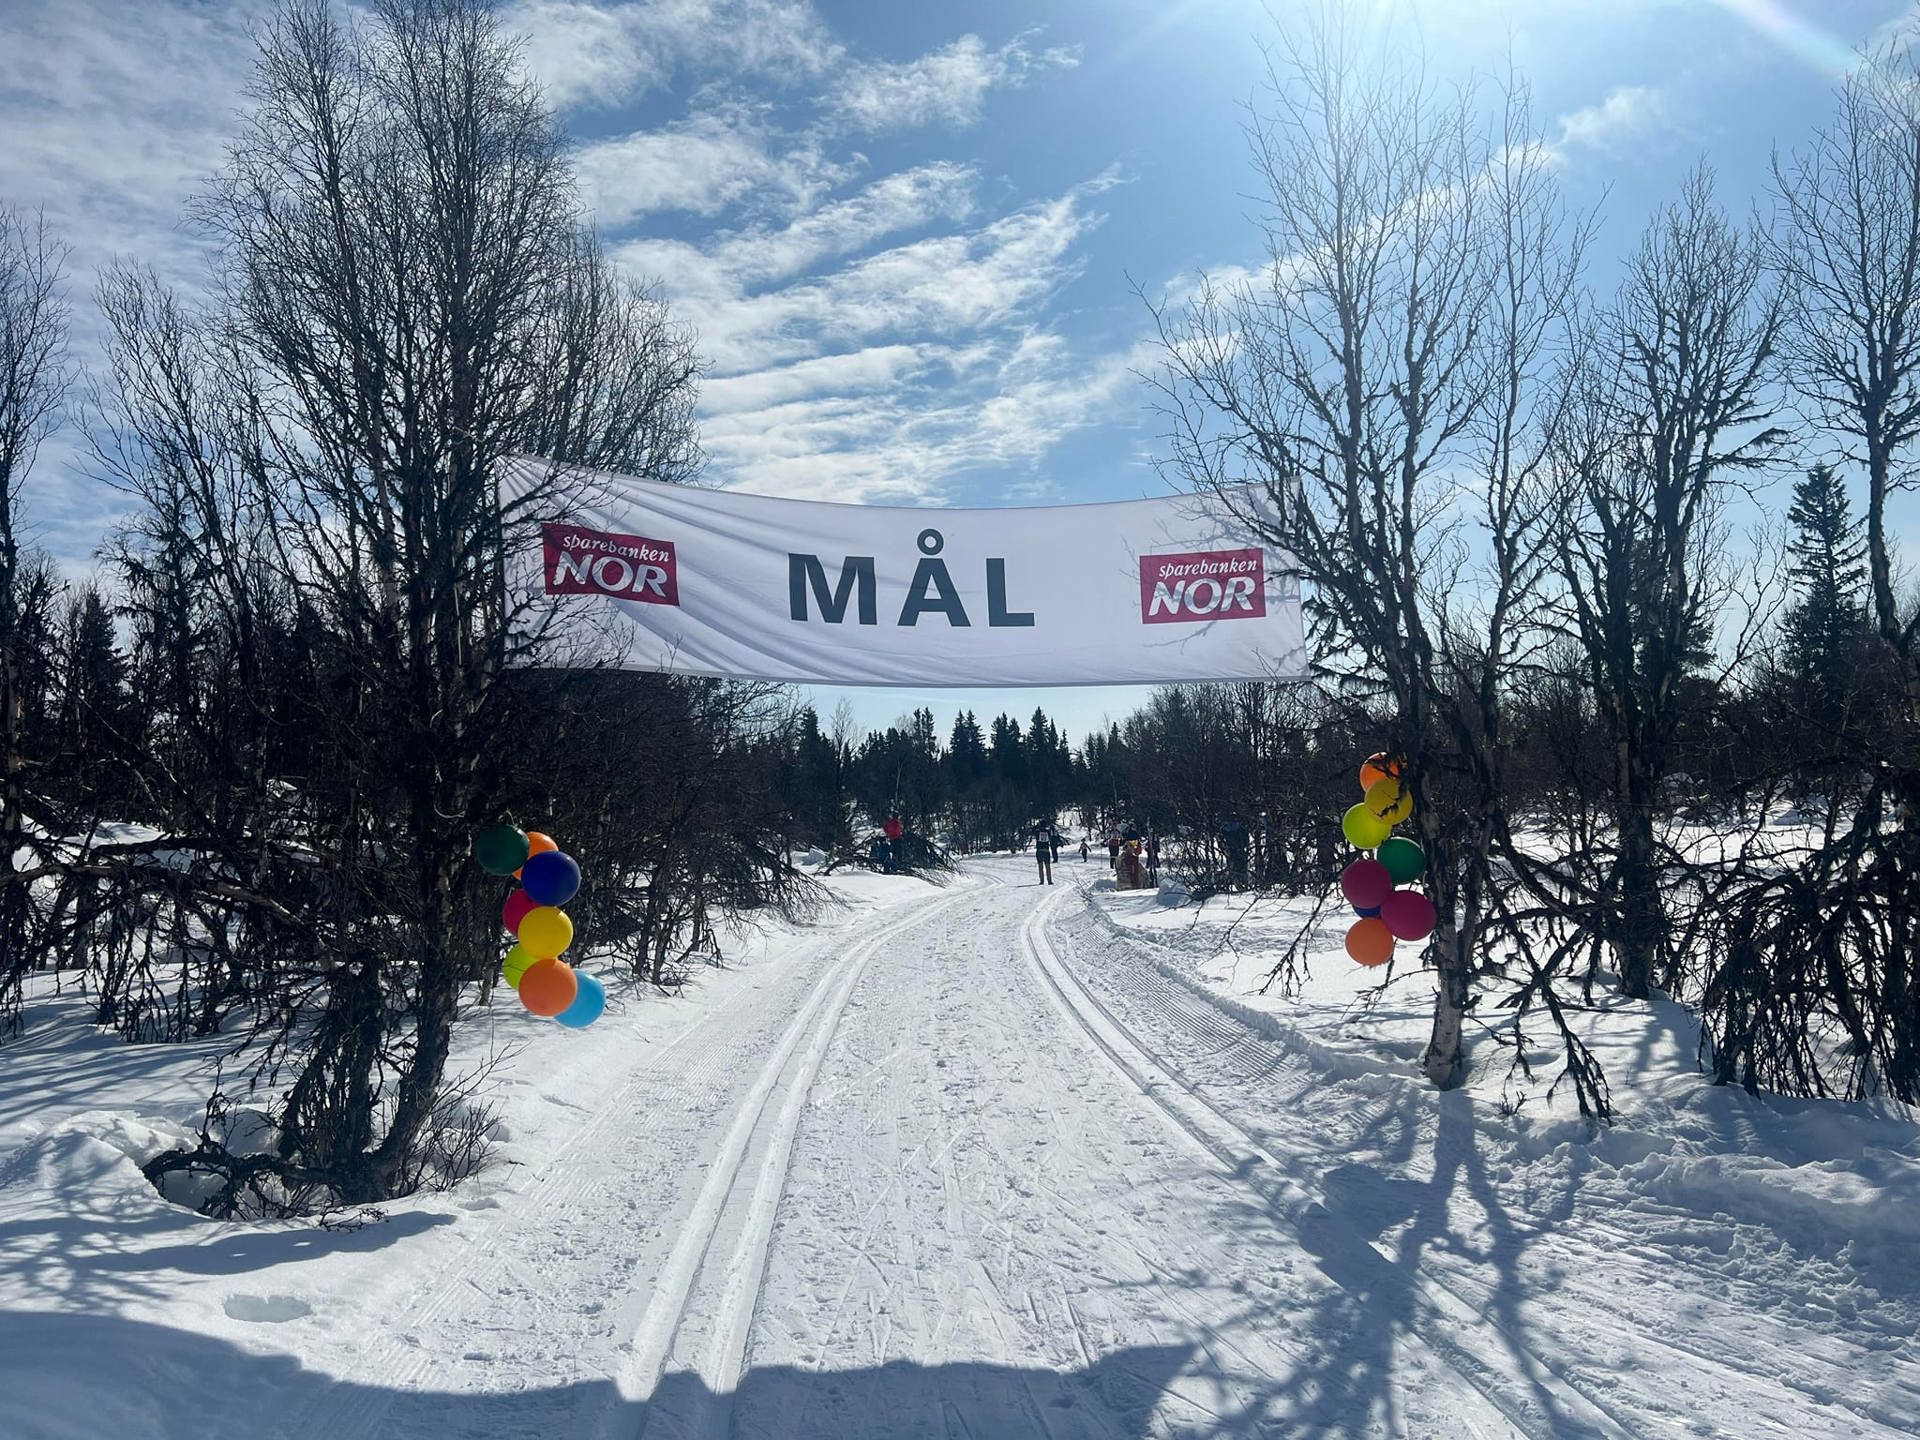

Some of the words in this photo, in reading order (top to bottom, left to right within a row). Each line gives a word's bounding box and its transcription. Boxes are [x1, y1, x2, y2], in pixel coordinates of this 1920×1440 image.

[562, 534, 670, 562] sparebanken
[552, 550, 668, 598] NOR
[787, 528, 1036, 628] MÅL
[1158, 557, 1257, 580] sparebanken
[1148, 576, 1256, 616] NOR
